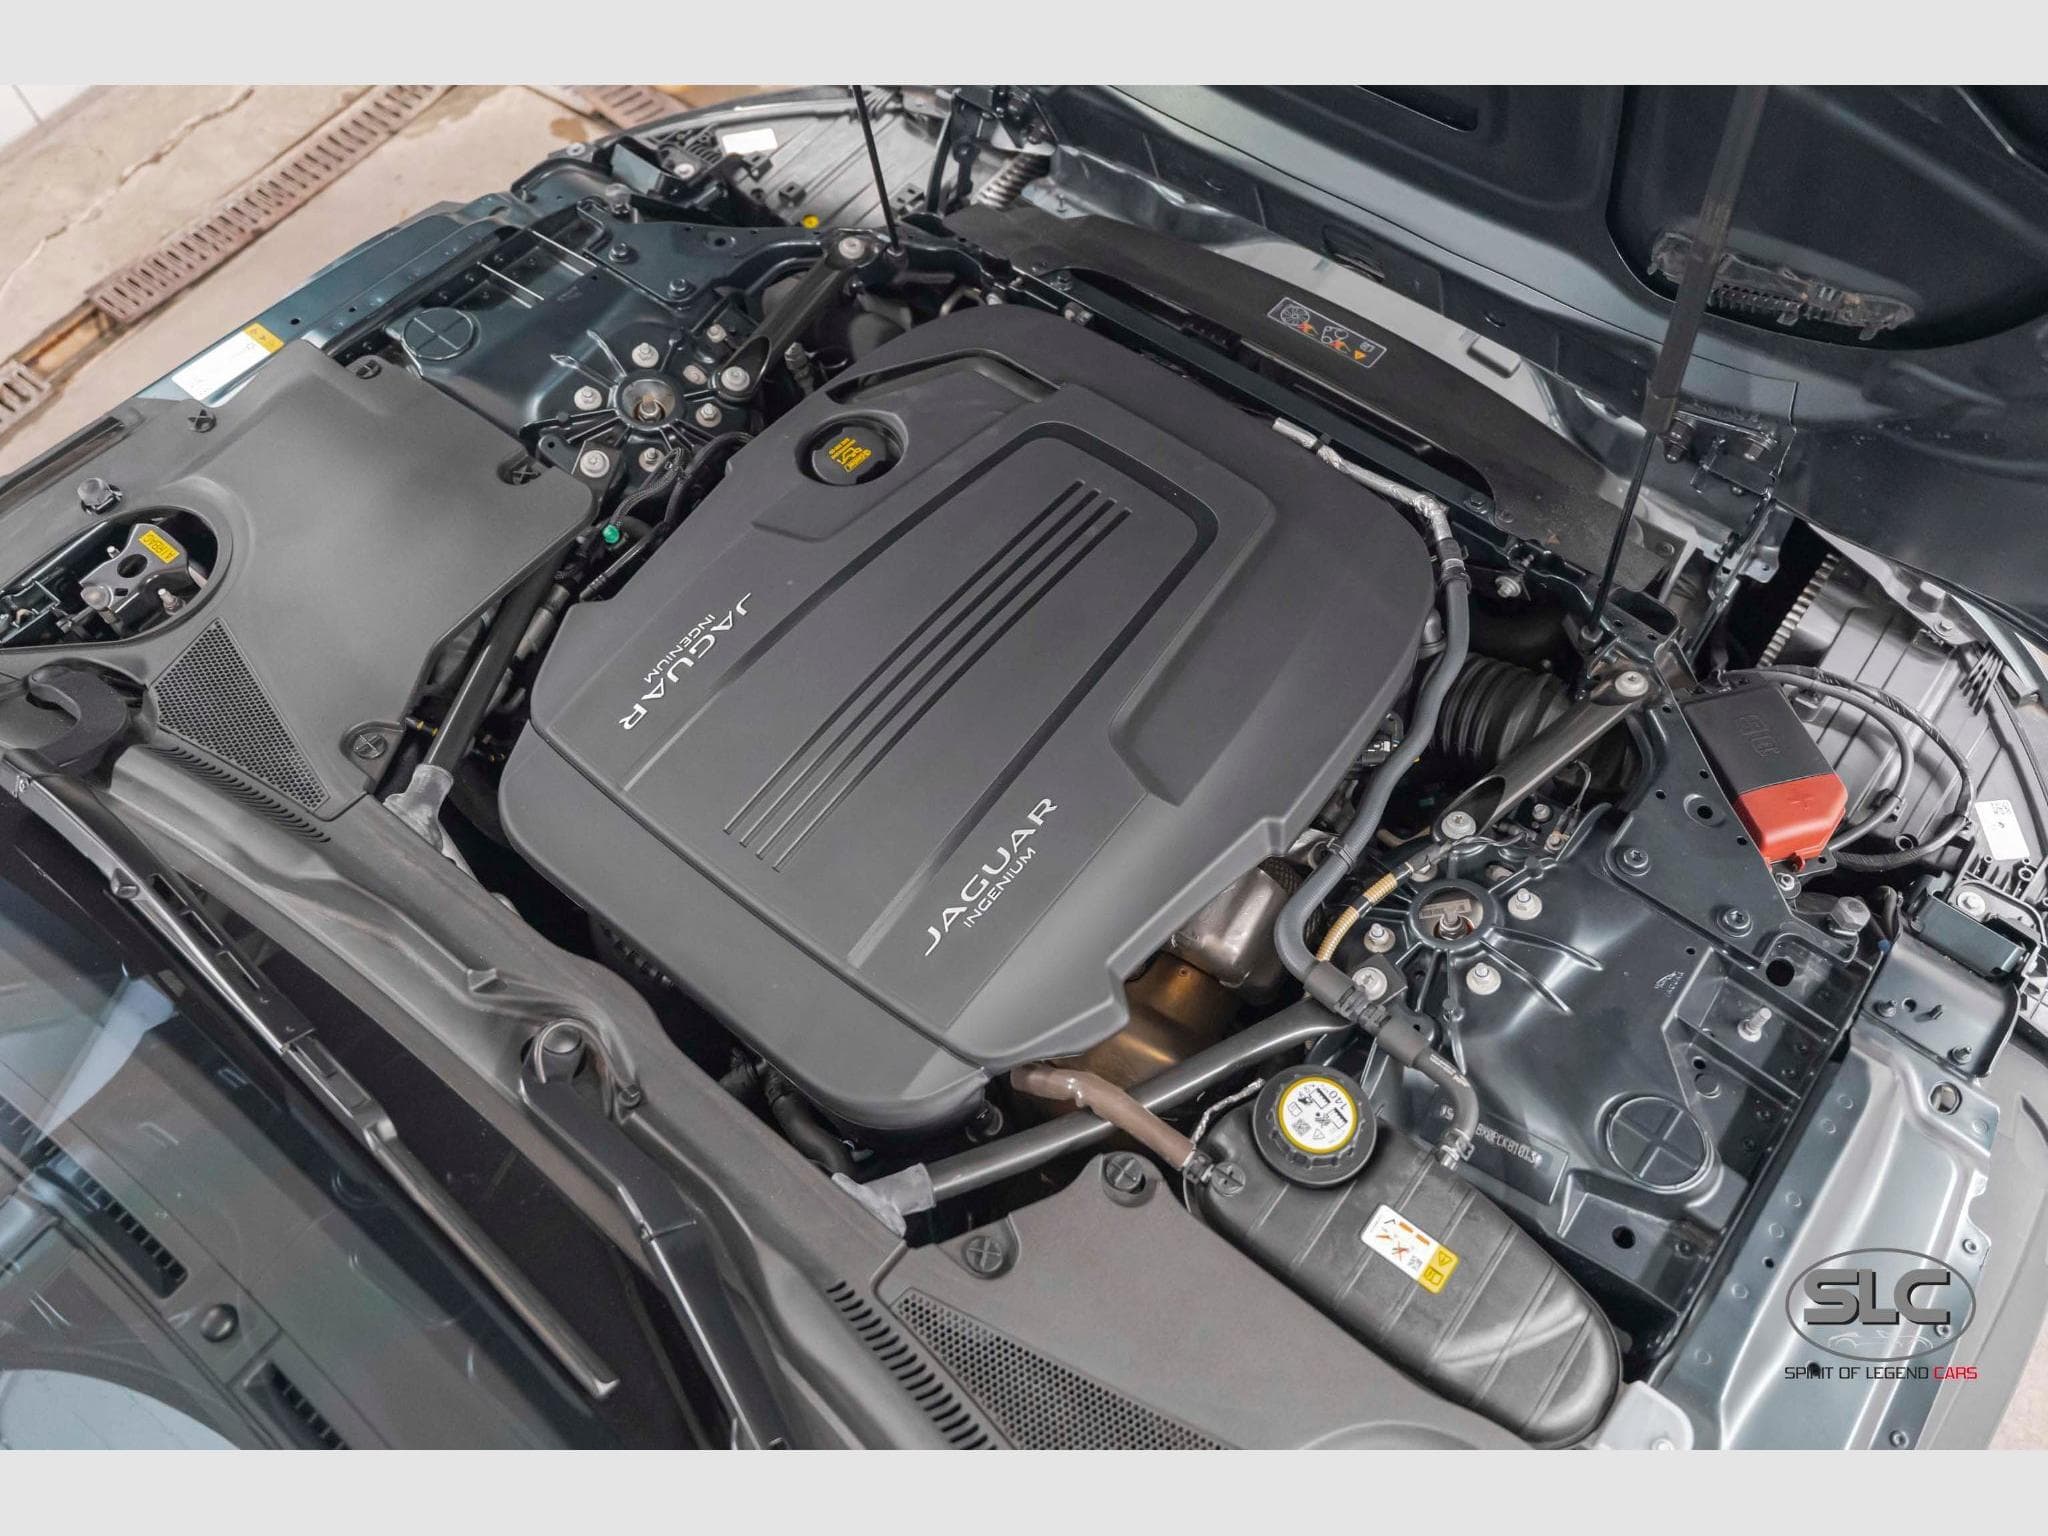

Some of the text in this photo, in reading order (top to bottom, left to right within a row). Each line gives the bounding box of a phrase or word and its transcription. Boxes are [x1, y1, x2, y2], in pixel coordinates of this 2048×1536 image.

[619, 593, 751, 730] JAGUAR
[643, 613, 716, 684] INGENIUM
[925, 799, 1058, 957] JAGUAR
[963, 847, 1037, 928] INGENIUM
